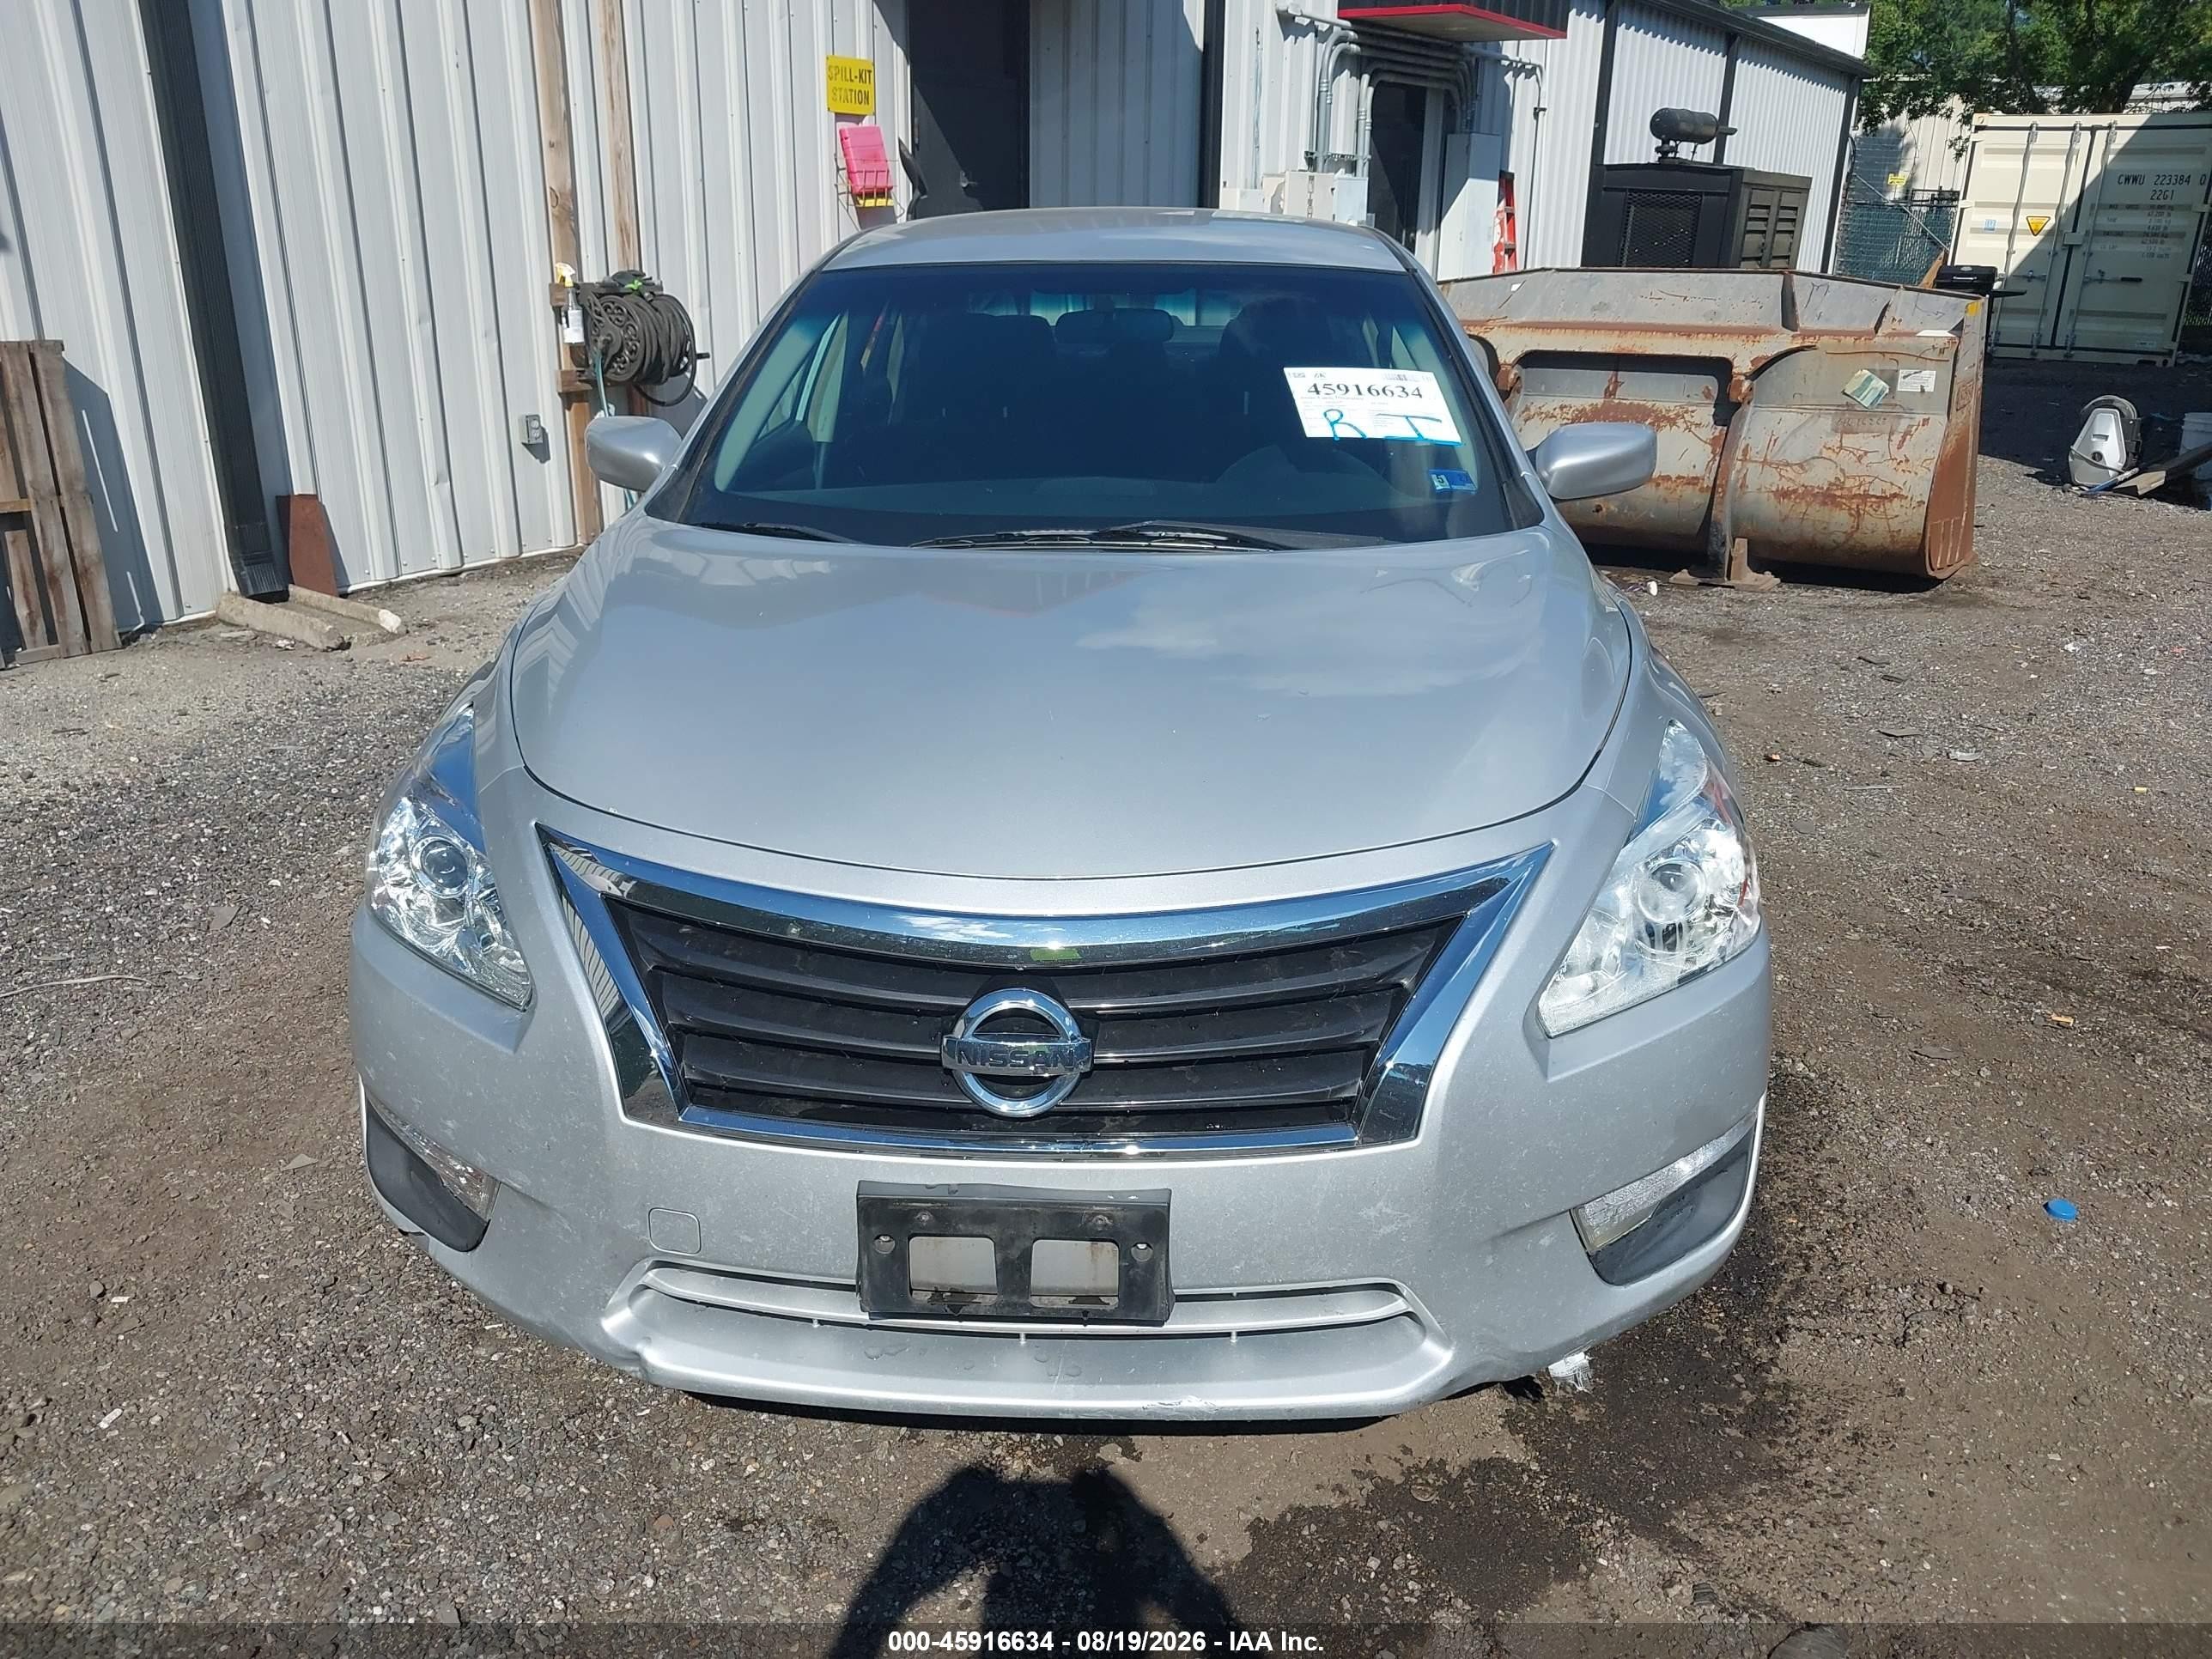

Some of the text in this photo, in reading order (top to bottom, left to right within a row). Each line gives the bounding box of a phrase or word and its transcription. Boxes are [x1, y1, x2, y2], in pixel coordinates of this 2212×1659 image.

[828, 64, 872, 85] SPILL-KIT
[831, 87, 870, 106] STATION
[2118, 173, 2146, 185] CWWU
[2154, 173, 2191, 185] 223384
[2150, 189, 2174, 201] 22G1
[1307, 382, 1423, 399] 45916634
[1323, 408, 1367, 441] R
[957, 1048, 1075, 1068] NISSAN
